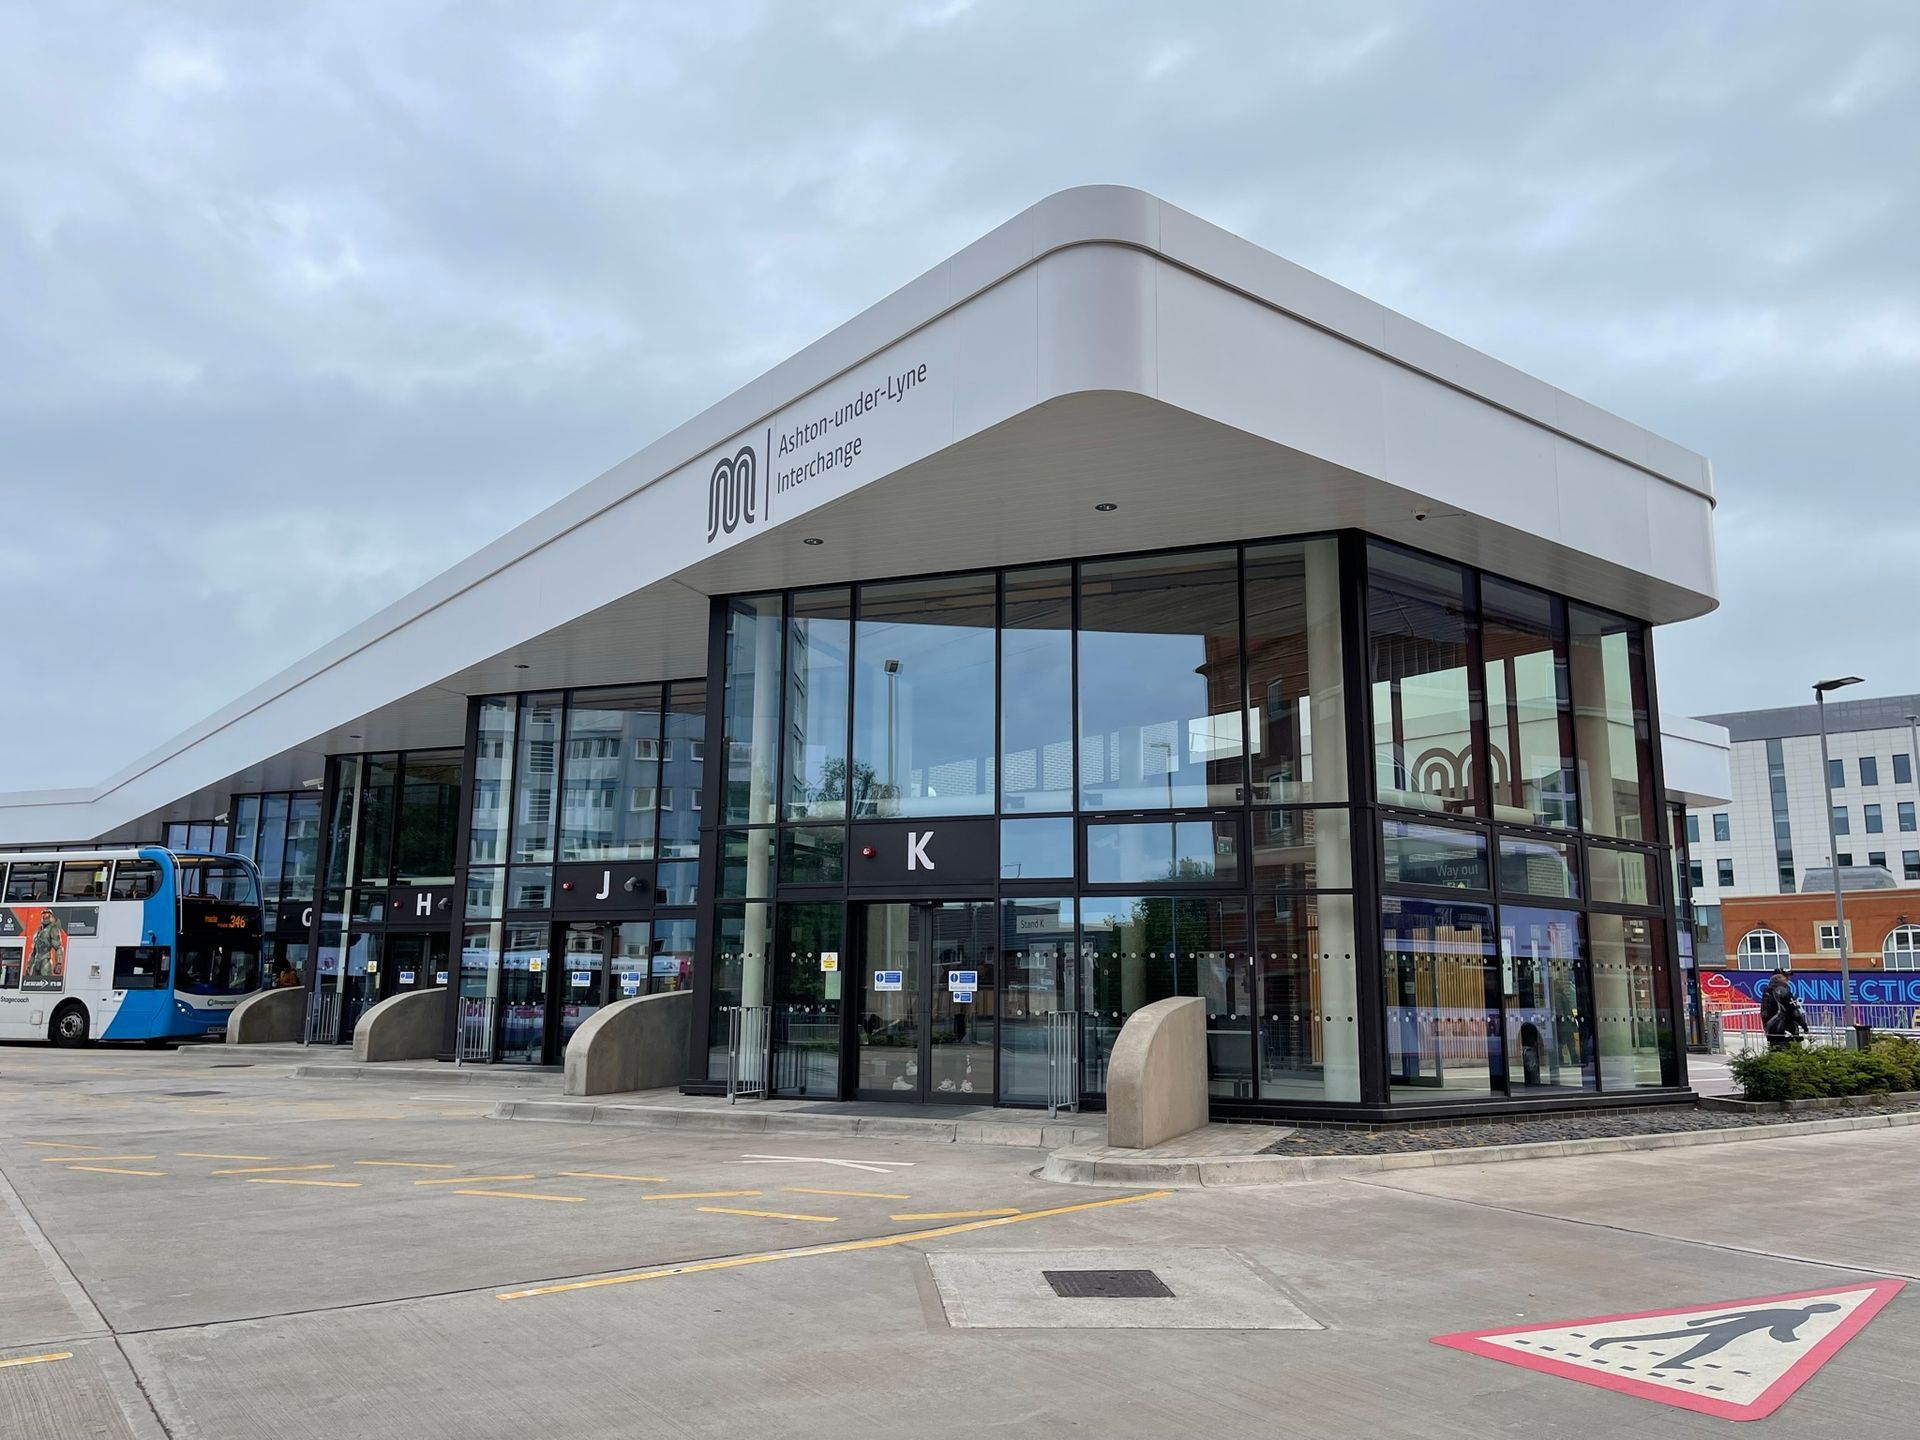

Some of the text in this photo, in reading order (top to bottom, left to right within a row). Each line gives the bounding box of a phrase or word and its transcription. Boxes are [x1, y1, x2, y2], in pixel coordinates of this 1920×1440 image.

[778, 363, 927, 458] Ashton-under-Lyne
[777, 437, 862, 494] Interchange
[908, 831, 935, 870] K
[595, 870, 611, 900] J
[1435, 863, 1479, 880] Way out
[302, 907, 313, 927] G
[416, 892, 432, 916] H
[1020, 920, 1045, 929] Stand K
